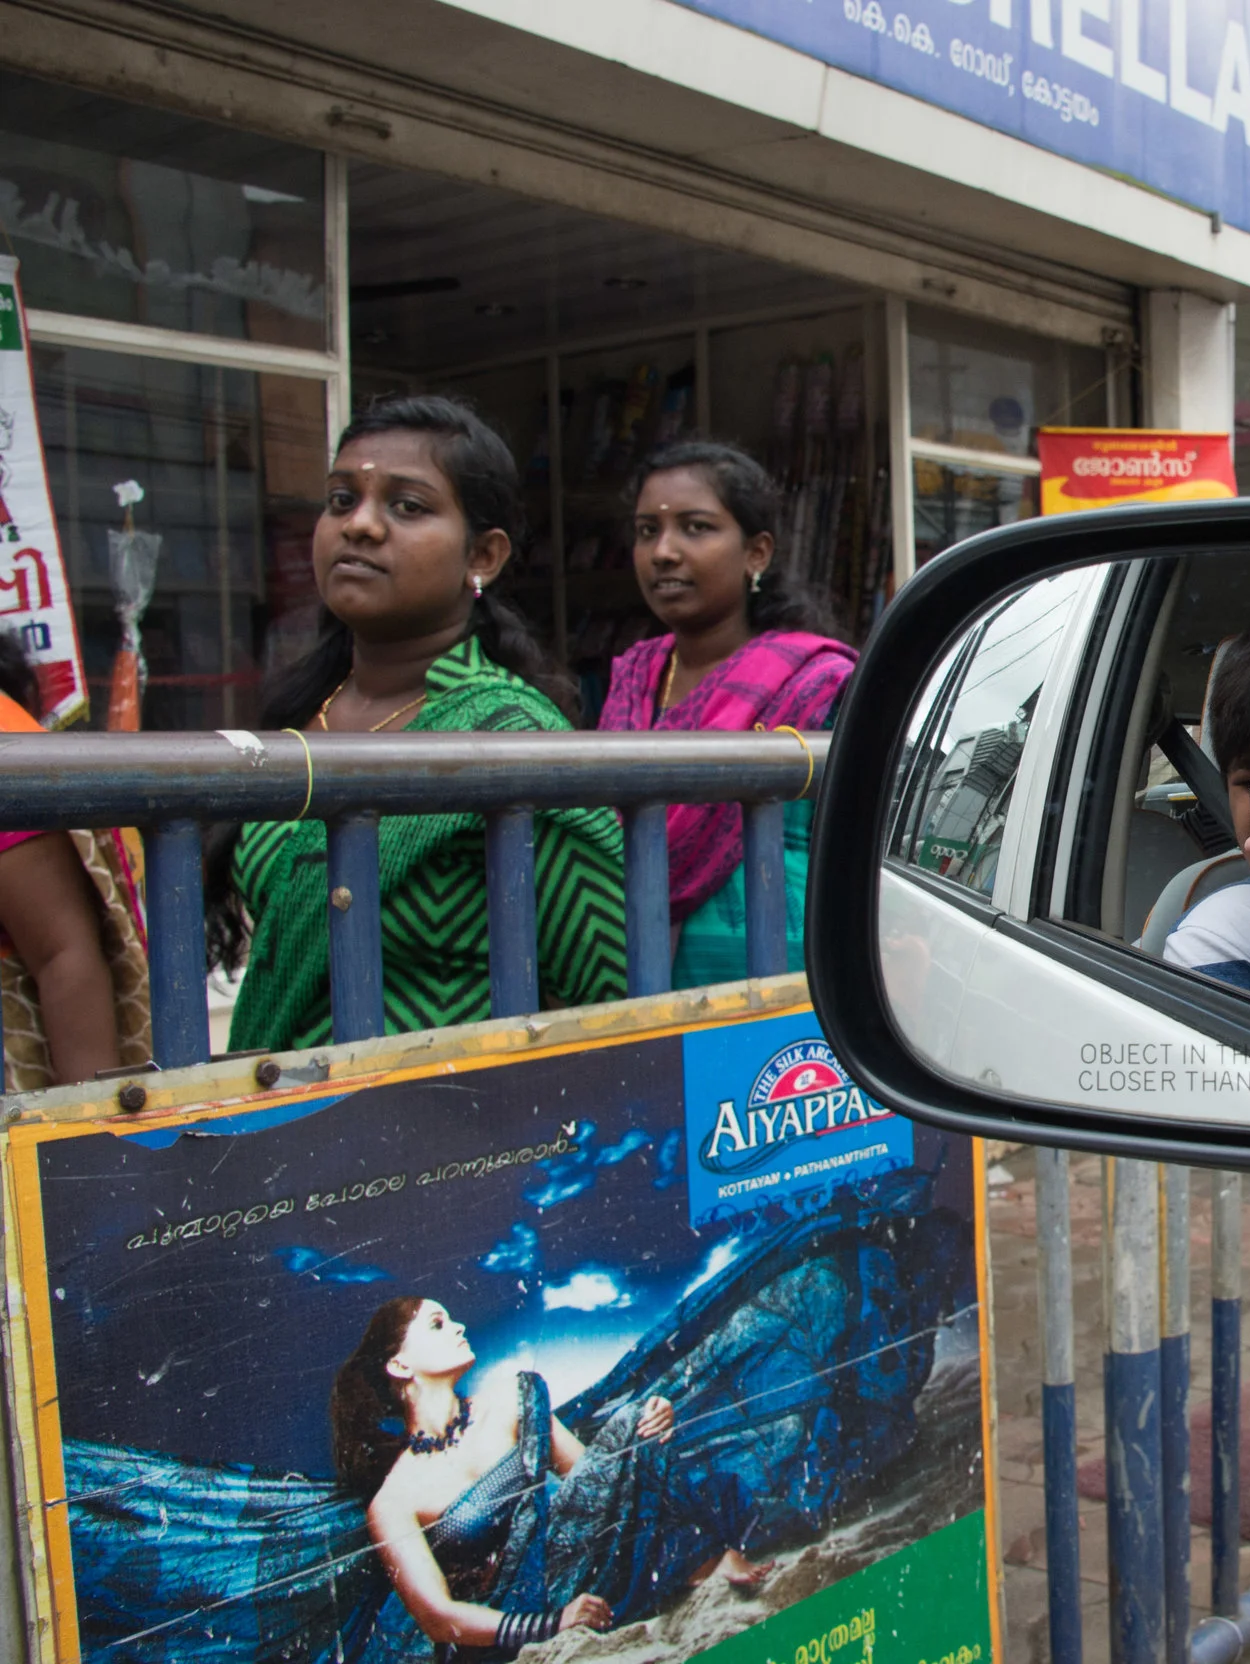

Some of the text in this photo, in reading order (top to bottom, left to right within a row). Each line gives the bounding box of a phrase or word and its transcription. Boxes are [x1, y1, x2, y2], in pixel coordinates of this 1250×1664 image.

[1021, 70, 1099, 126] കോട്ടയം
[1080, 1043, 1173, 1065] OBJECT
[1182, 1043, 1206, 1065] IN
[753, 1069, 778, 1102] THE
[774, 1046, 804, 1074] SILK
[1078, 1070, 1177, 1092] CLOSER
[304, 1173, 406, 1212] പോലെ
